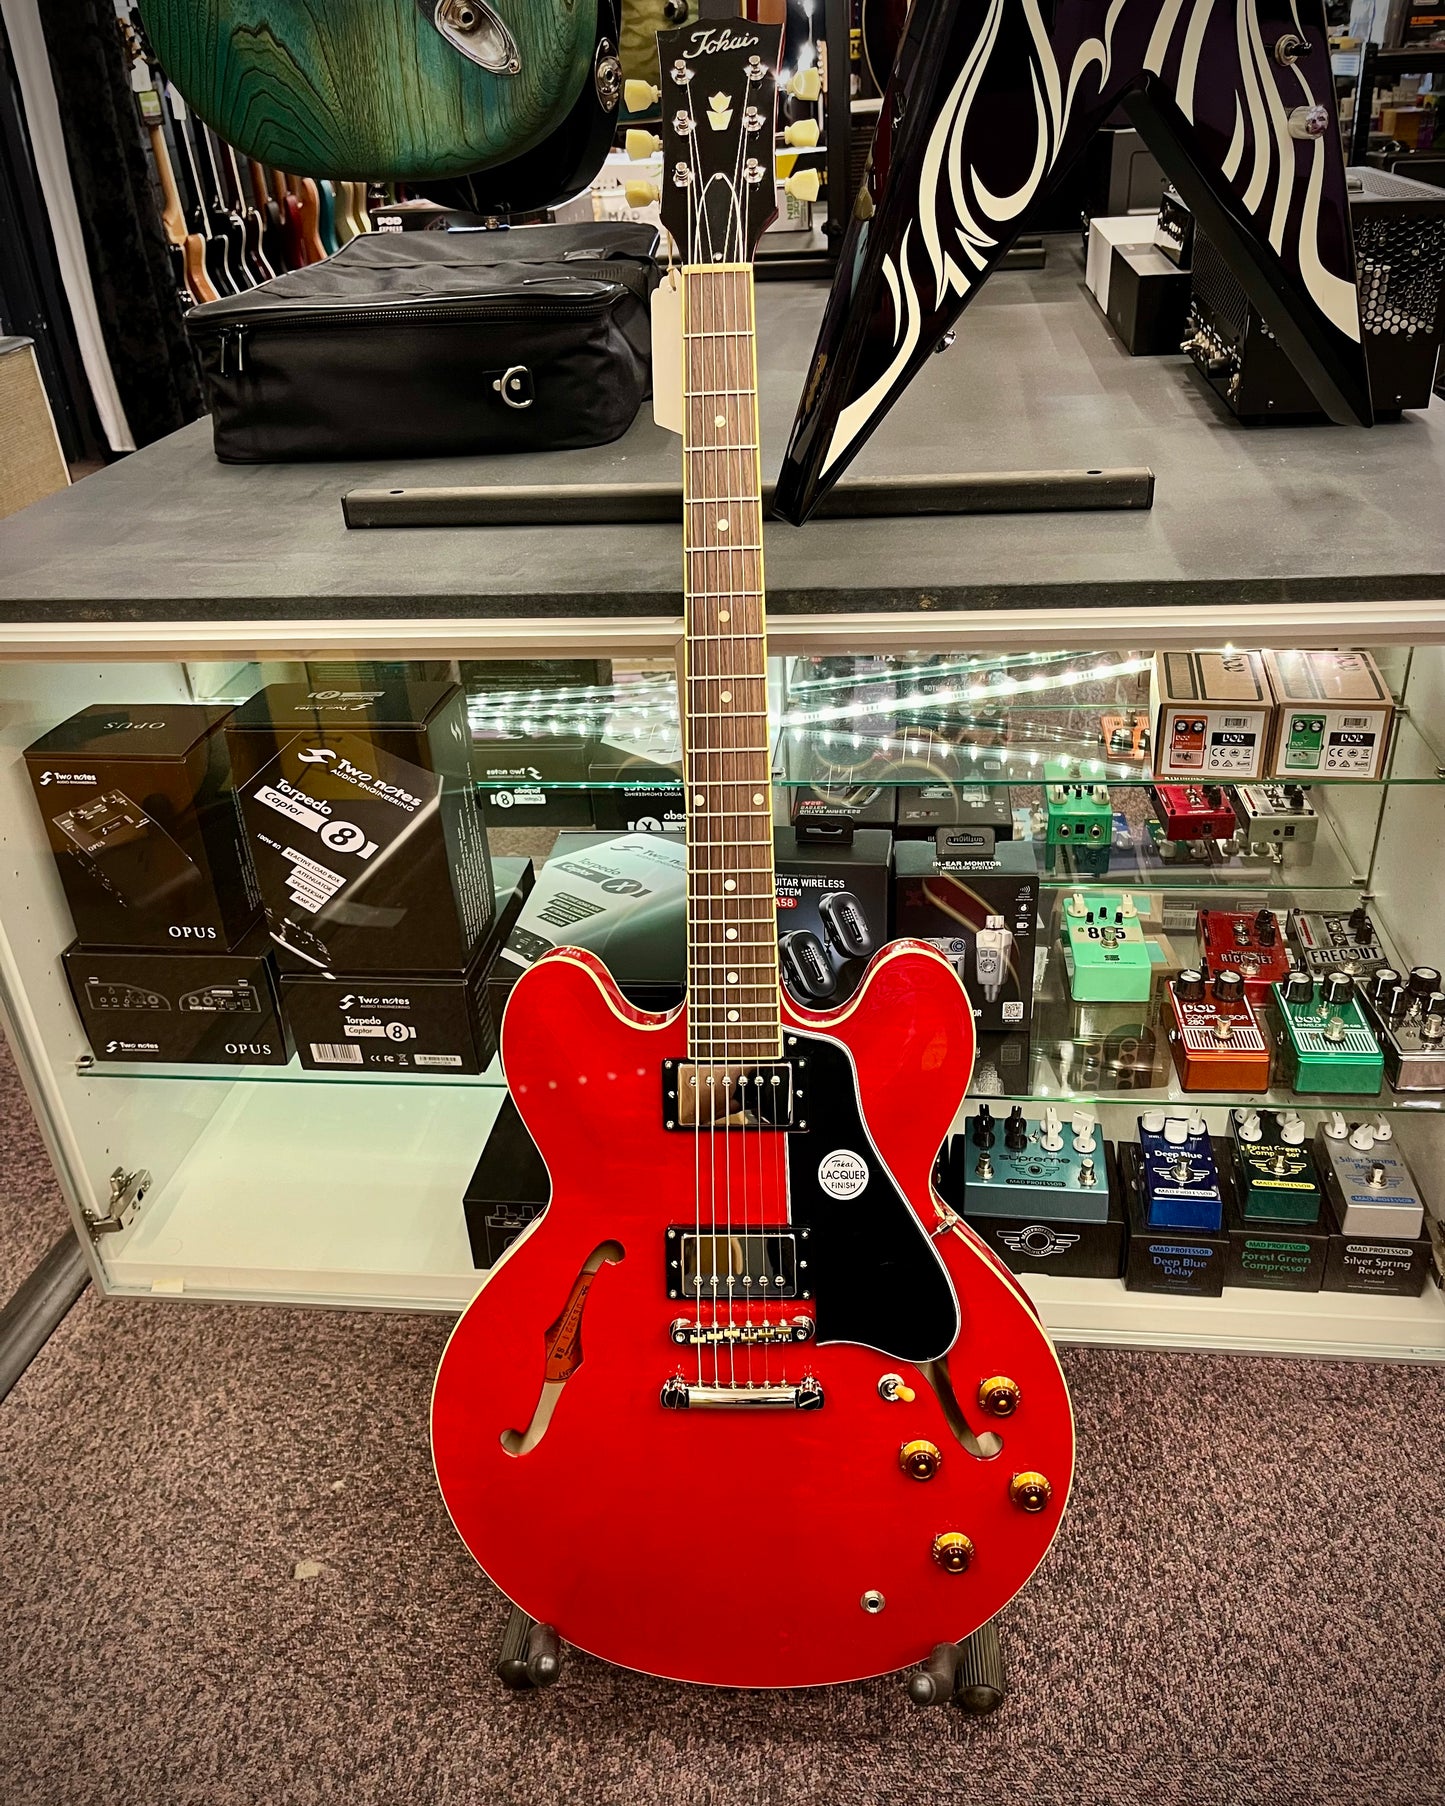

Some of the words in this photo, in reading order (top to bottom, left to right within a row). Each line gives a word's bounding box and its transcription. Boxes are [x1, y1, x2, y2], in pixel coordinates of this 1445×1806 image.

[682, 28, 759, 59] Tokai
[103, 721, 166, 730] OPUS
[54, 772, 72, 780] Two
[338, 758, 373, 781] Two
[373, 779, 422, 807] notes
[330, 768, 358, 784] AUDIO
[358, 781, 415, 812] ENGINEERING
[276, 778, 333, 815] Torpedo
[264, 792, 304, 816] Captor
[296, 870, 333, 891] ATTENUATOR
[775, 877, 799, 887] UITAR
[800, 878, 846, 889] WIRELESS
[775, 887, 802, 897] YSTEM
[168, 925, 217, 939] OPUS
[358, 995, 380, 1004] Two
[382, 997, 410, 1005] notes
[345, 1015, 382, 1026] Torpedo
[348, 1027, 373, 1035] Captor
[119, 1041, 136, 1049] Two
[225, 1043, 272, 1055] OPUS
[1246, 1143, 1273, 1151] Forest
[1274, 1145, 1302, 1154] Green
[1154, 1150, 1179, 1159] Deep
[1180, 1151, 1203, 1159] Blue
[1249, 1150, 1300, 1158] Compsor
[831, 1160, 854, 1168] Tokai
[1339, 1156, 1364, 1164] Silver
[821, 1170, 866, 1180] LACQUER
[831, 1181, 856, 1189] FINISH
[1171, 1247, 1209, 1255] PROFESSOR
[1267, 1242, 1307, 1250] PROFESSOR
[1369, 1247, 1409, 1255] PROFESSOR
[1153, 1256, 1180, 1268] Deep
[1183, 1258, 1207, 1268] Blue
[1241, 1251, 1275, 1261] Forest
[1277, 1254, 1311, 1264] Green
[1242, 1260, 1307, 1272] Compressor
[1343, 1255, 1373, 1266] Silver
[1375, 1258, 1411, 1271] Spring
[1164, 1266, 1193, 1278] Delay
[1358, 1266, 1395, 1276] Reverb
